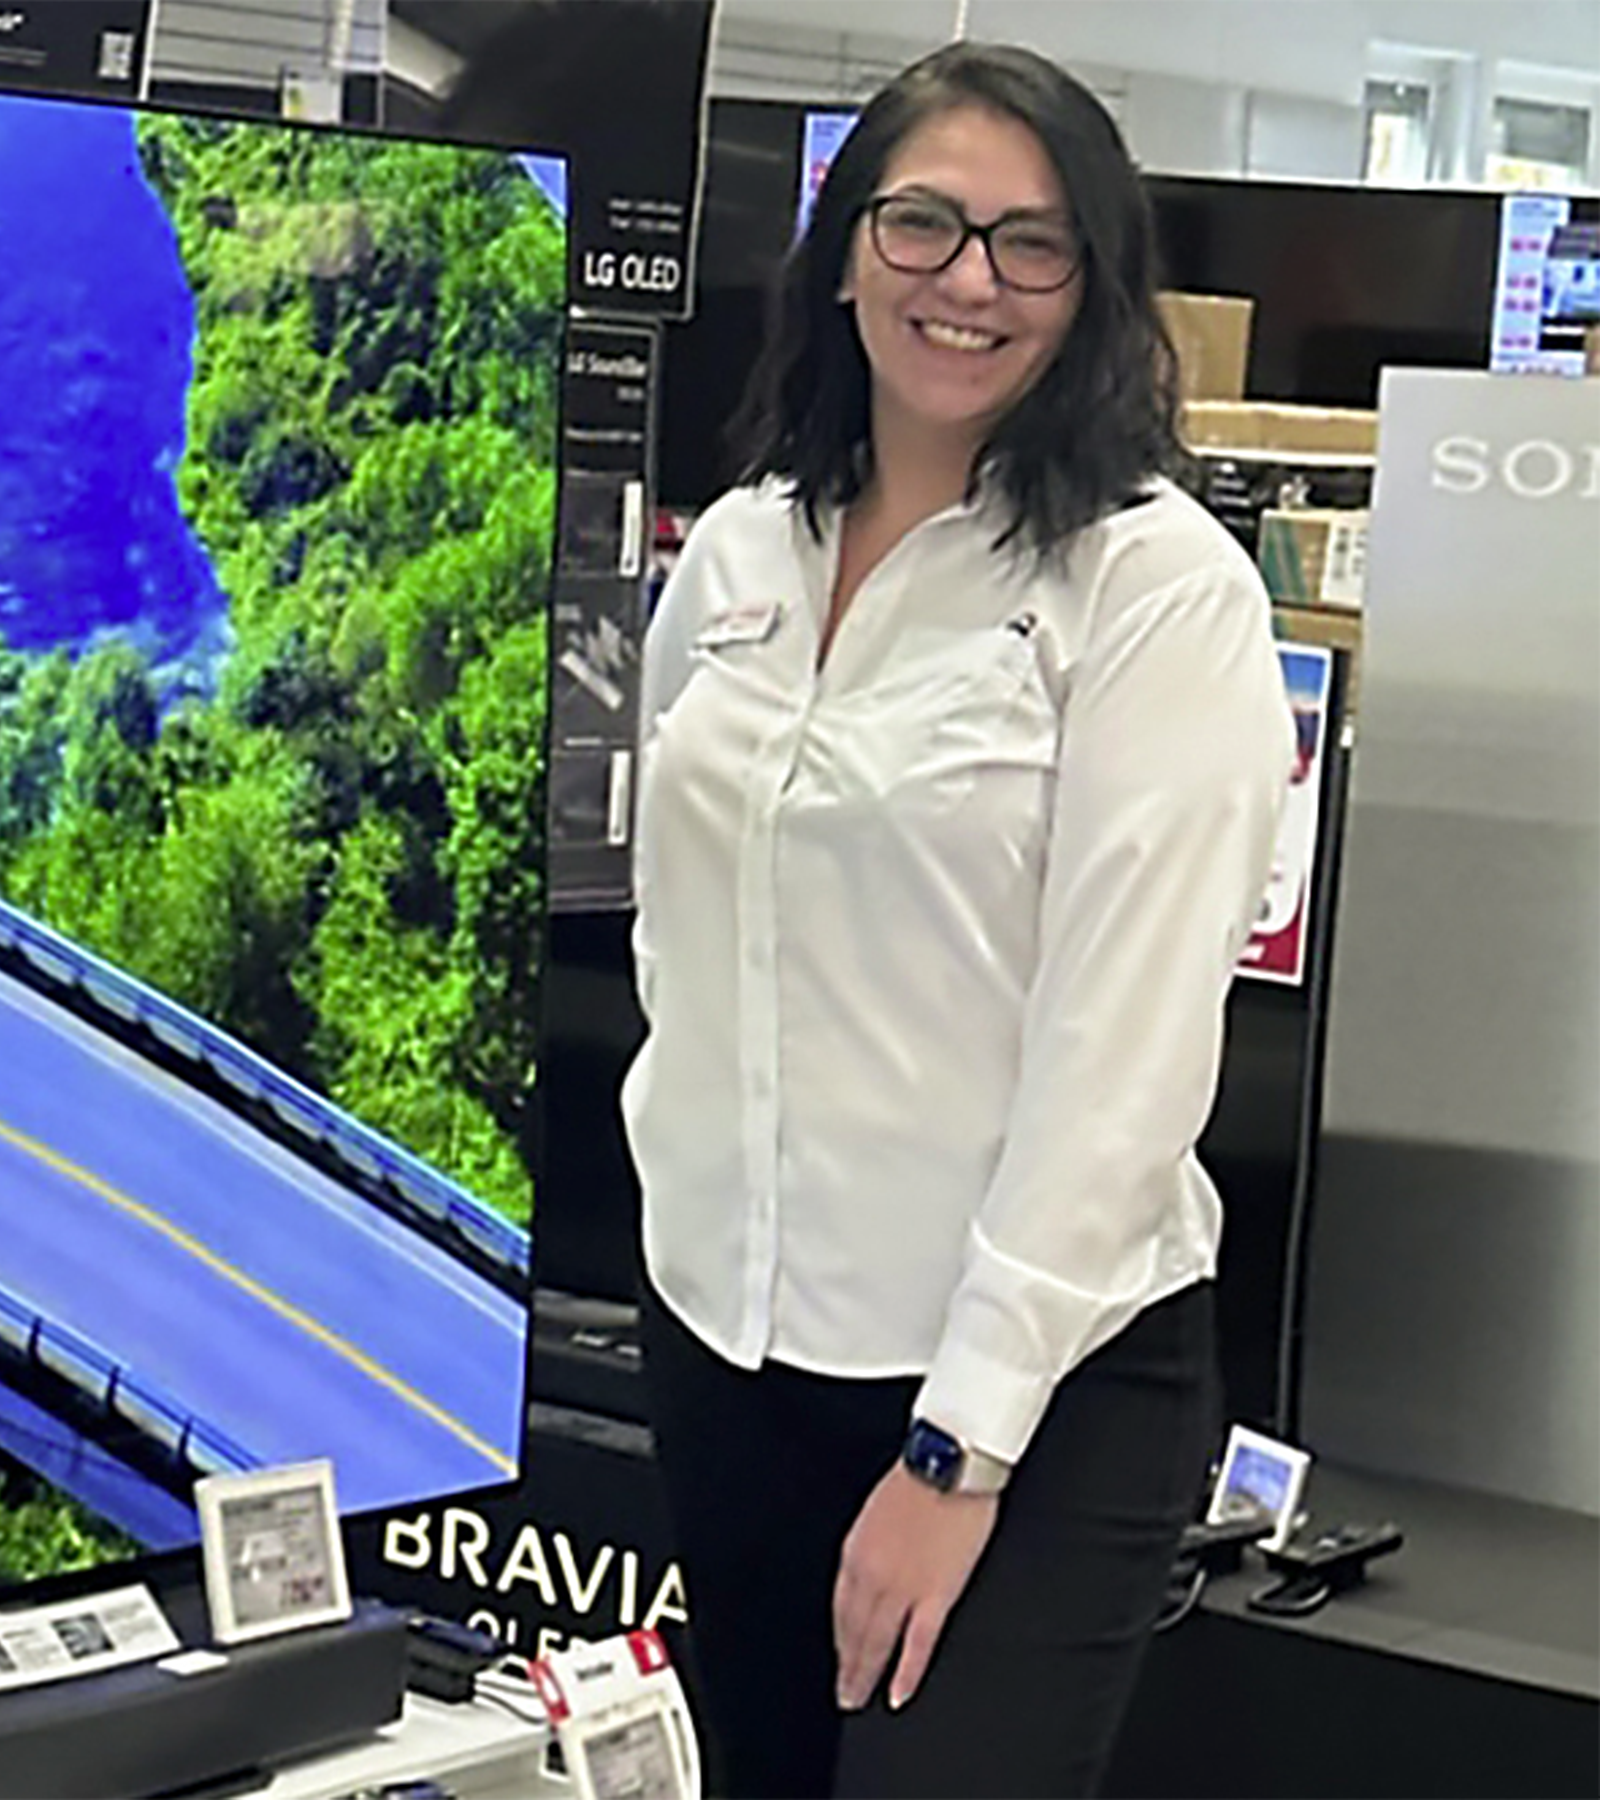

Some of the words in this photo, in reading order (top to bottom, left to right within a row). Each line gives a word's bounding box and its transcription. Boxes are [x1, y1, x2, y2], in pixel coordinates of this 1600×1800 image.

[584, 251, 616, 288] LG
[621, 253, 681, 292] OLED
[383, 1507, 689, 1631] BRAVIA
